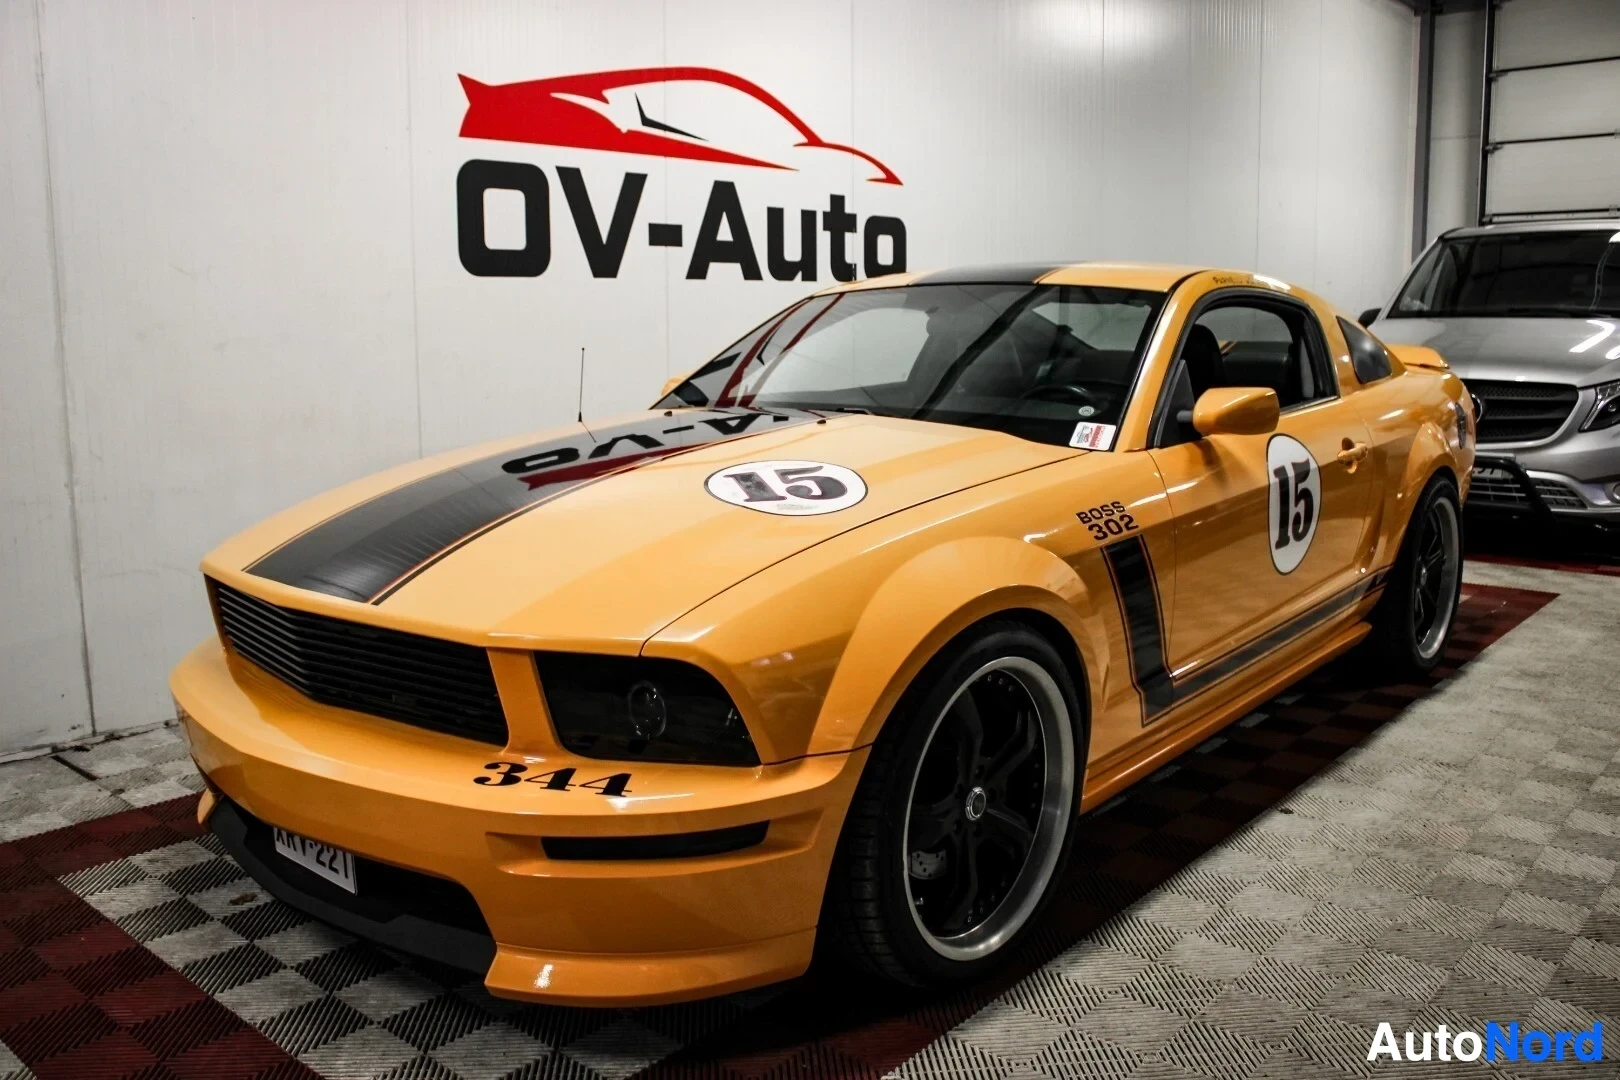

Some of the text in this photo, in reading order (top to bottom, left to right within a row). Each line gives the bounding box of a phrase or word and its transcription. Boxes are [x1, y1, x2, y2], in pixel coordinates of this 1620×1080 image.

[456, 158, 907, 281] OV-Auto
[723, 465, 848, 503] 15
[1076, 501, 1126, 524] BOSS
[1273, 457, 1314, 550] 15
[1088, 513, 1139, 541] 302
[473, 761, 633, 798] 344
